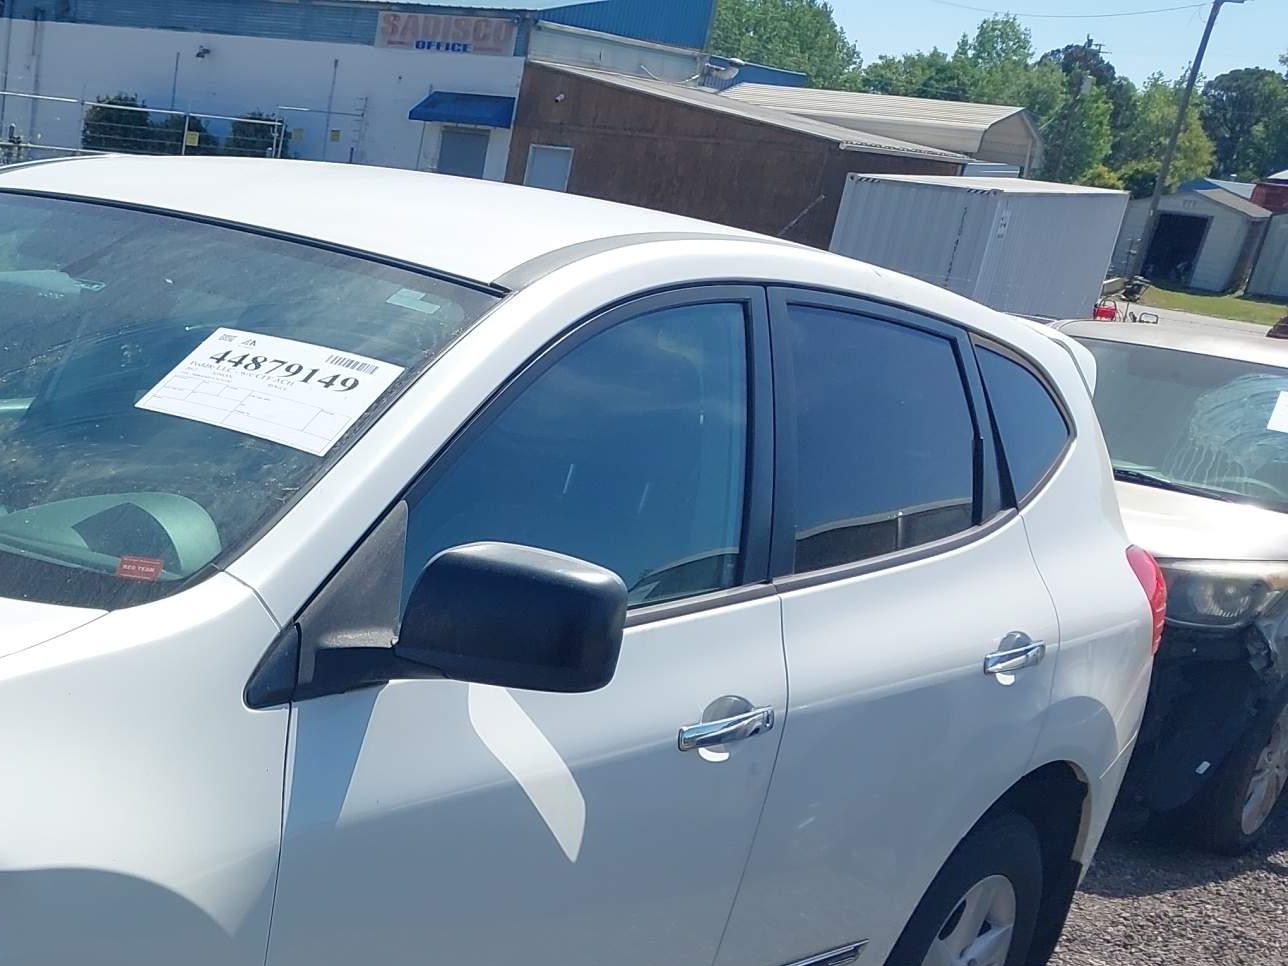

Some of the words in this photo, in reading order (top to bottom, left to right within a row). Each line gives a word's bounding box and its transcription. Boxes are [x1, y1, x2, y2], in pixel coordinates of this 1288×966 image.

[383, 14, 513, 42] SADISCO
[415, 41, 472, 53] OFFICE
[209, 350, 360, 392] 44879149
